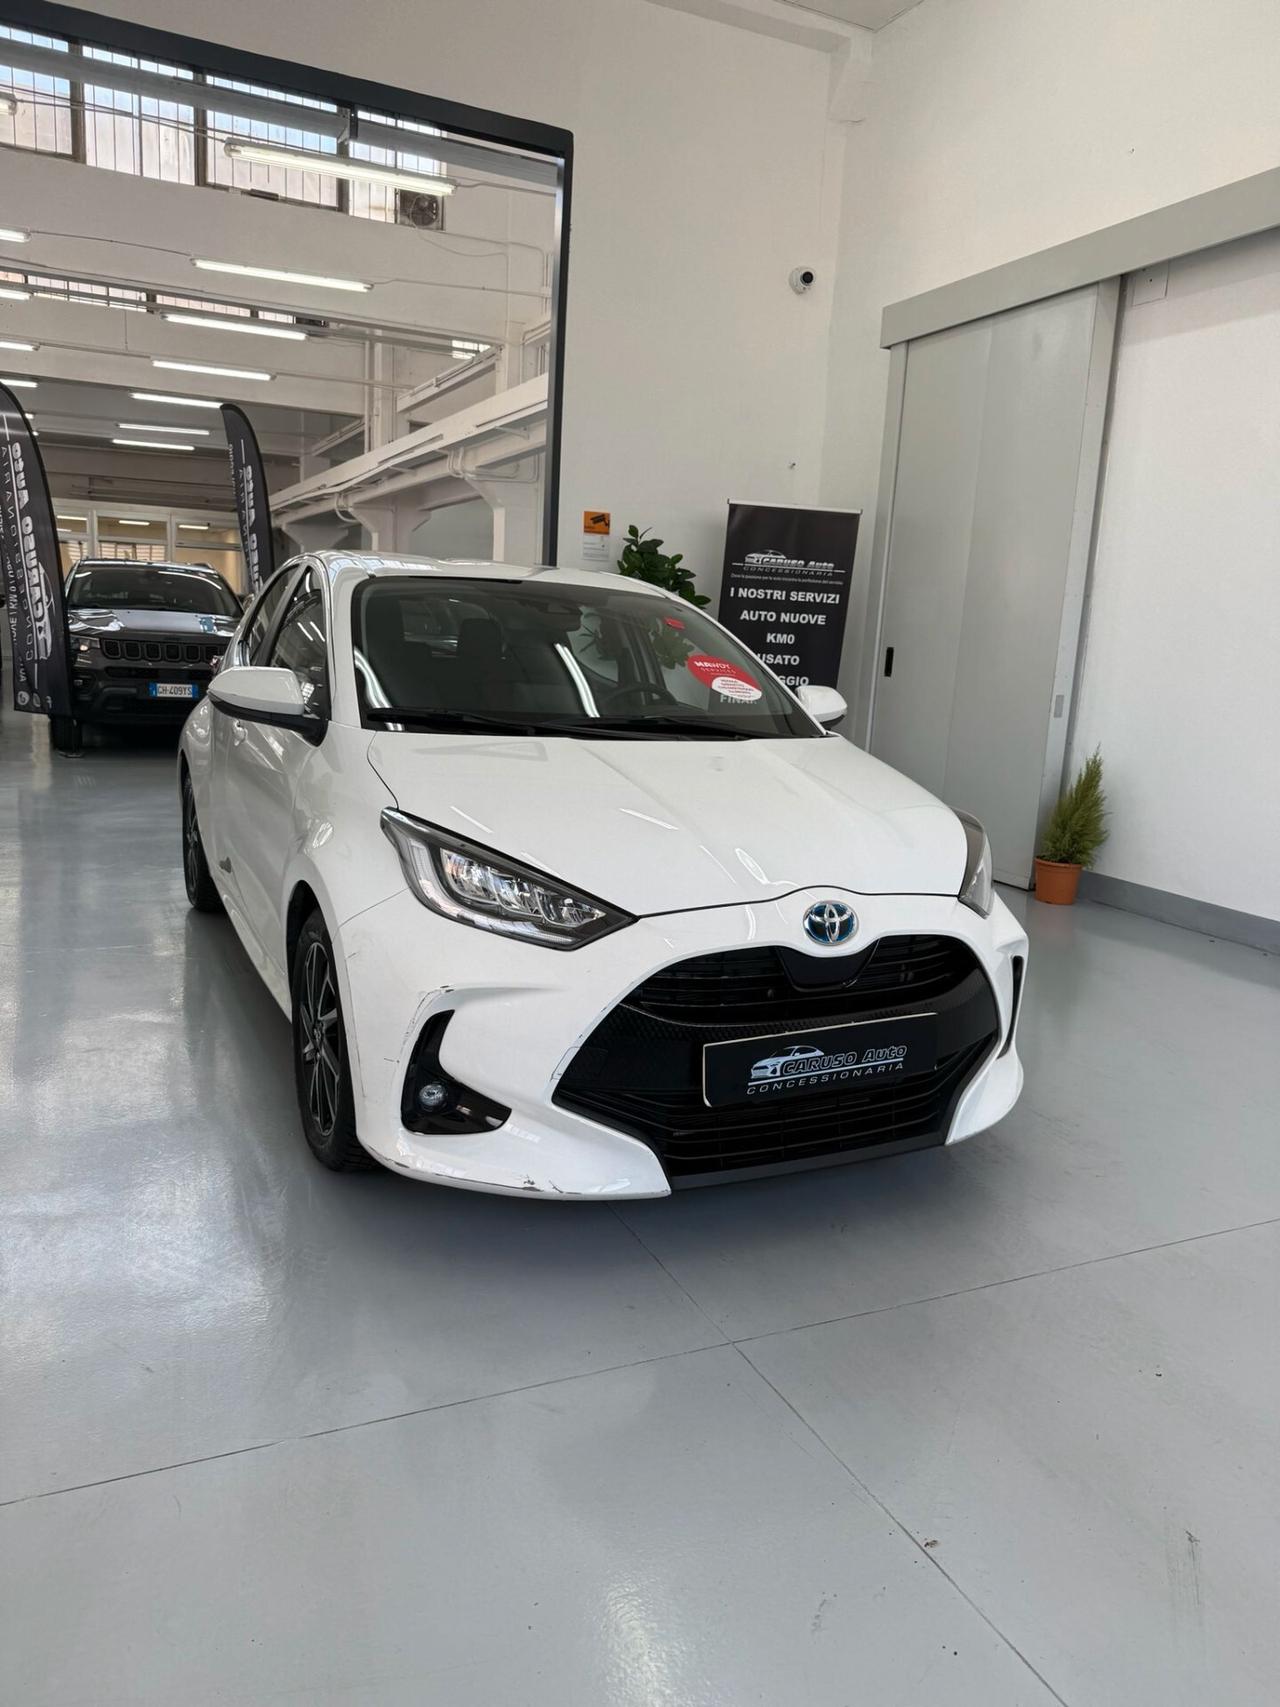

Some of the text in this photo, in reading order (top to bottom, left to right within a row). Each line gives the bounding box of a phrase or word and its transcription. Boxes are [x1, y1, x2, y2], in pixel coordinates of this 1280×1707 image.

[730, 587, 840, 604] I NOSTRI SERVIZI
[740, 610, 826, 625] AUTO NUOVE
[782, 1045, 907, 1075] CARUSO Auto
[746, 1063, 904, 1095] CONCESSIONARIA
